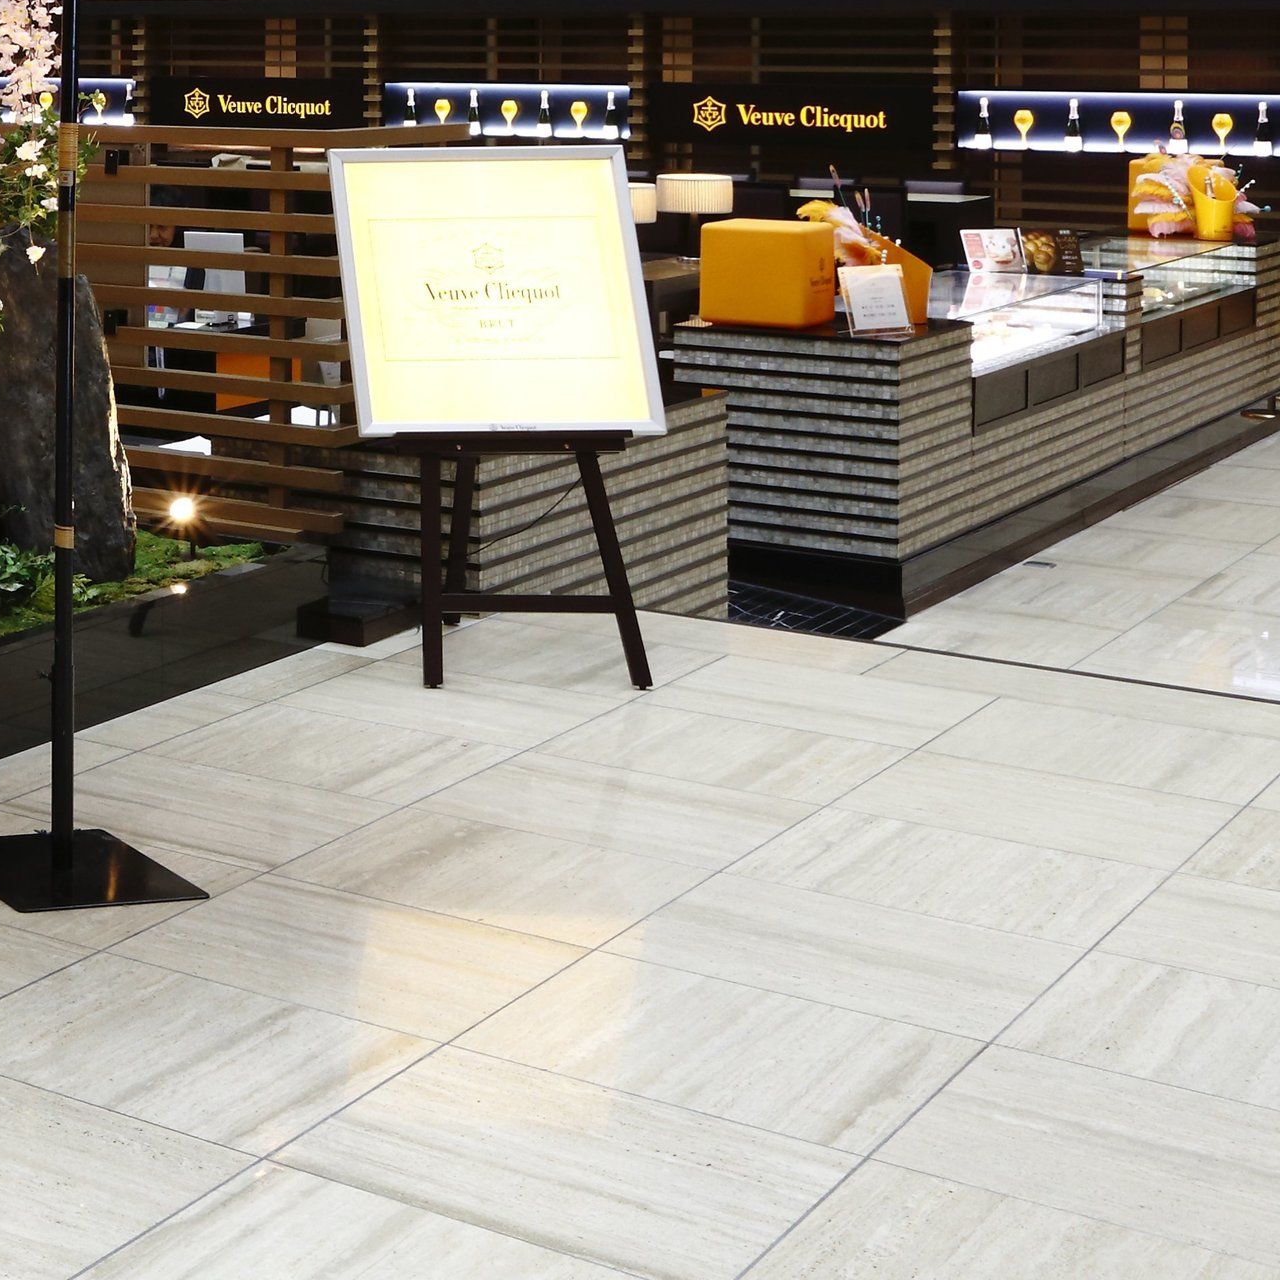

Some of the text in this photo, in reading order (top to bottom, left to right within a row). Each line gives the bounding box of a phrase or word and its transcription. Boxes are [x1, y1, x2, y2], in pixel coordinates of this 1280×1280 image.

[217, 94, 332, 119] Veuve Clicquot
[736, 104, 887, 132] Veuve Clicquot
[425, 281, 561, 303] Veuve Clicquot
